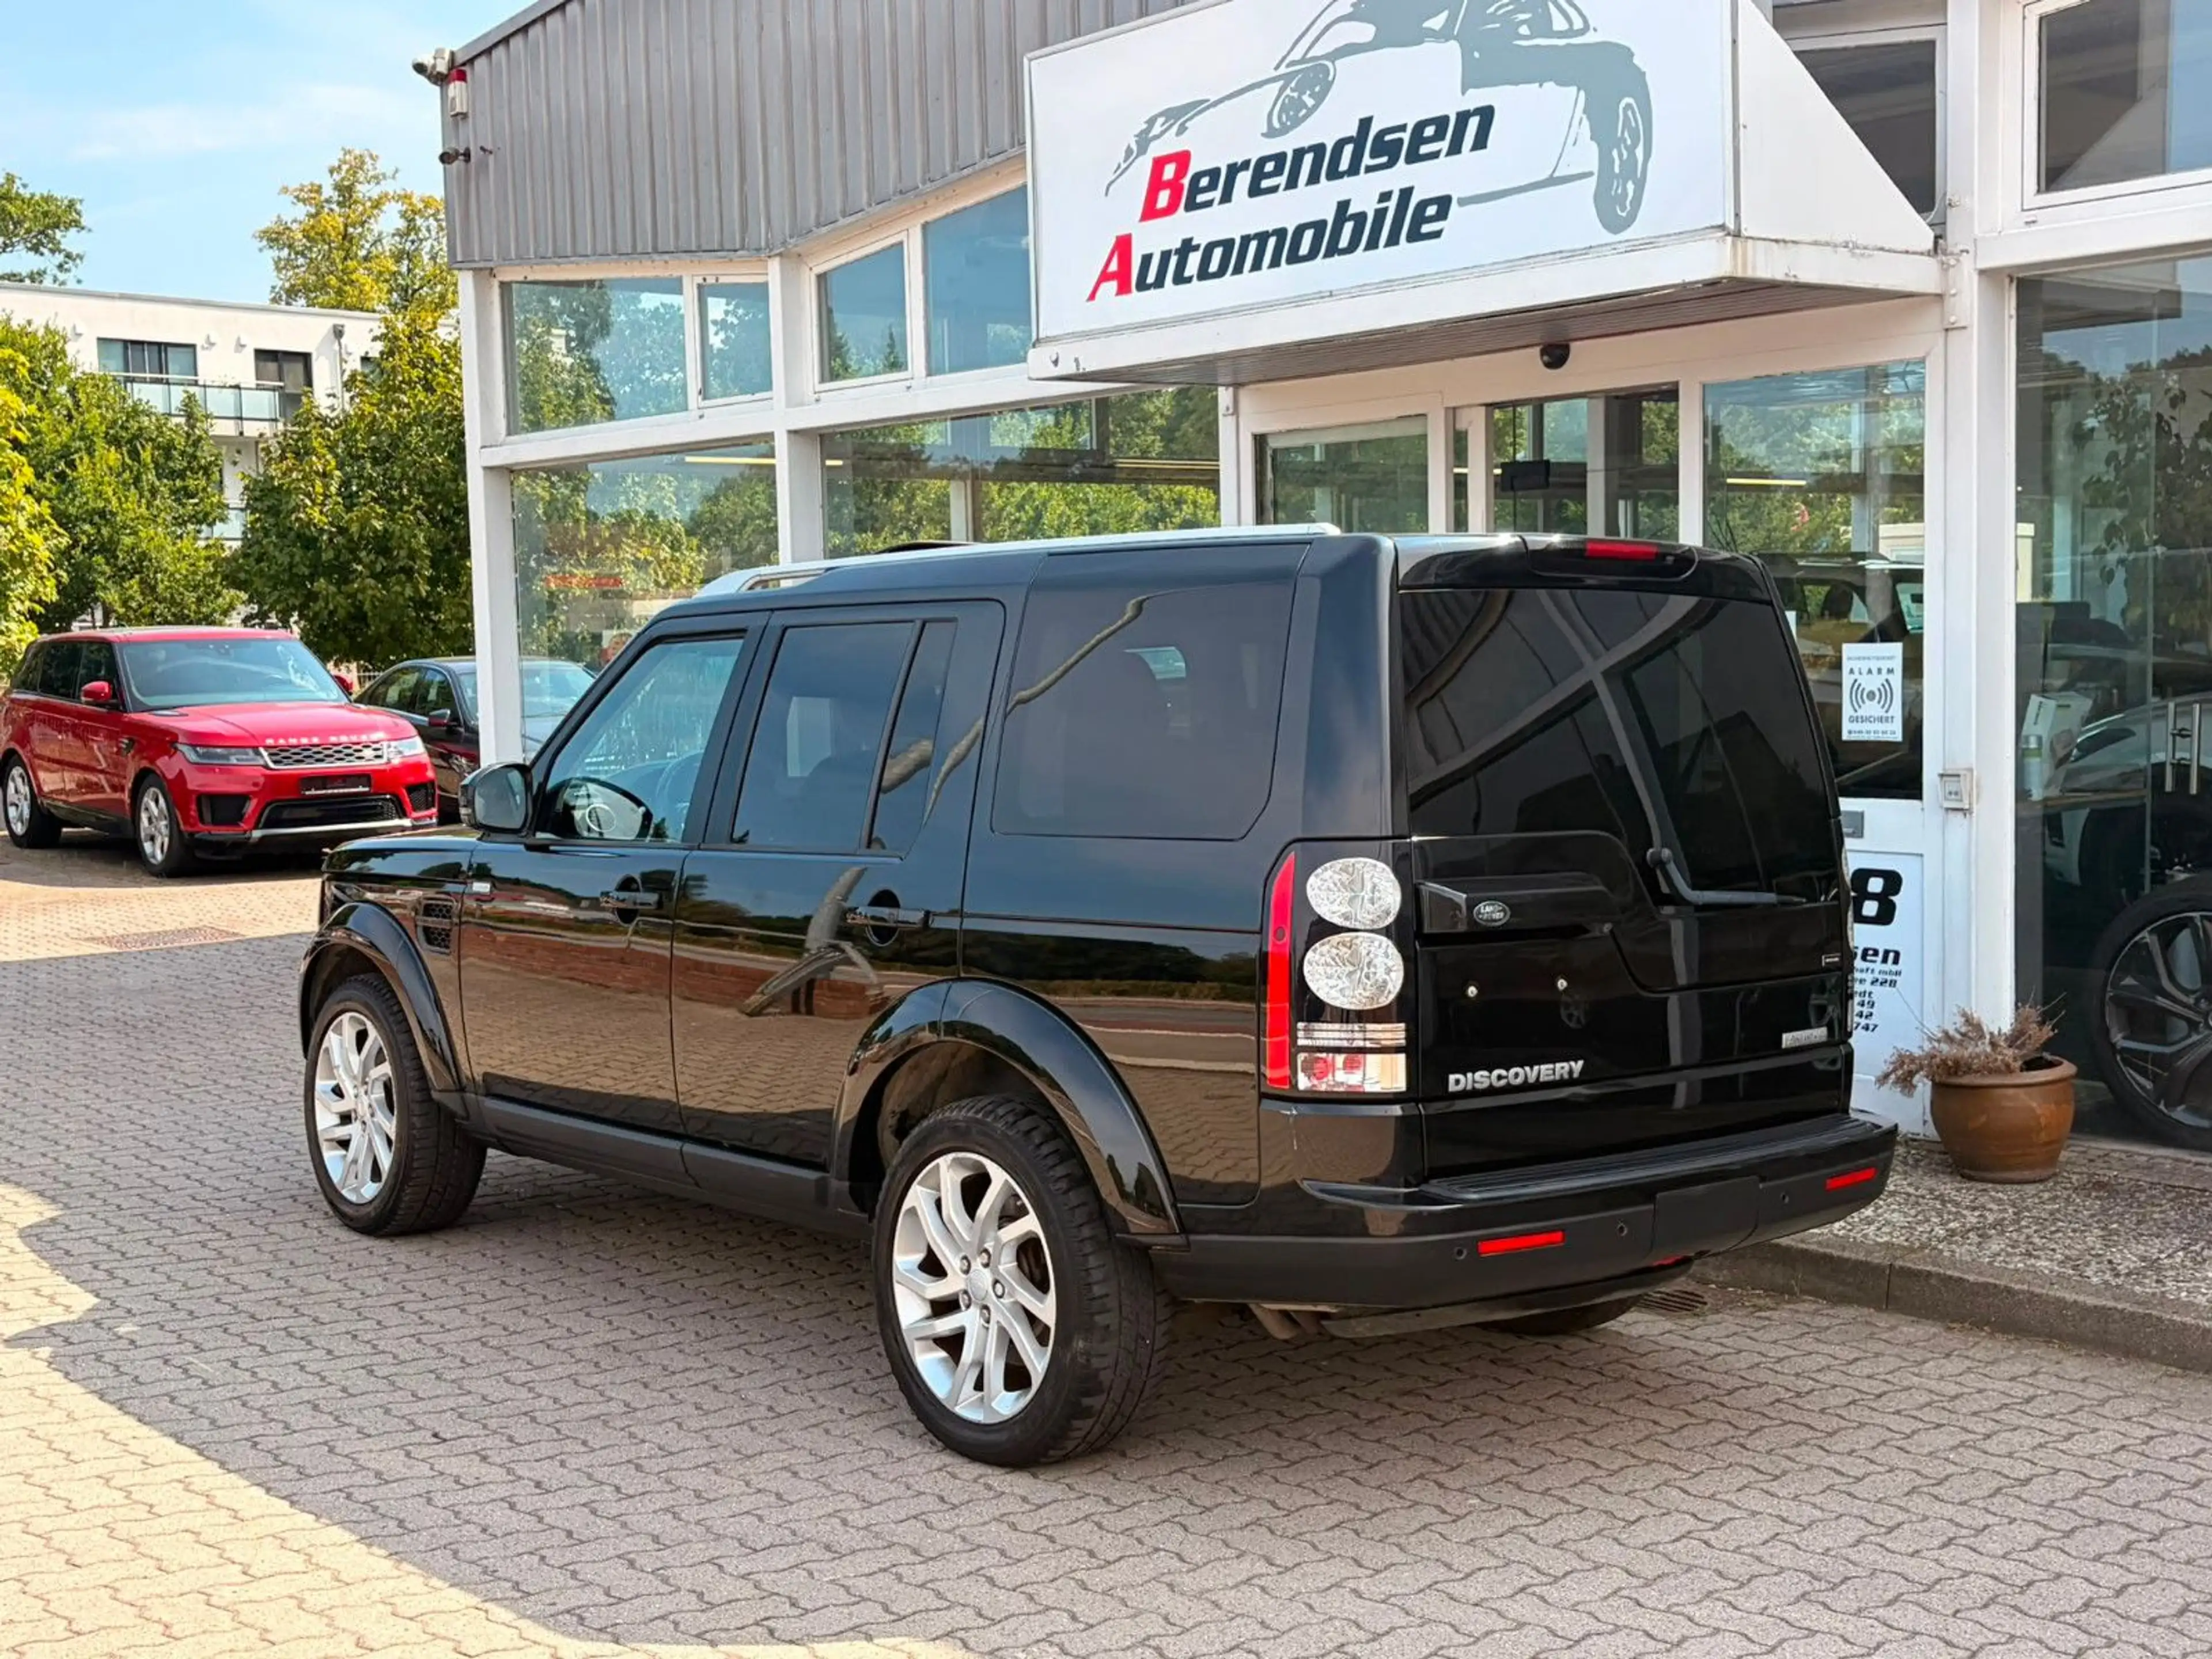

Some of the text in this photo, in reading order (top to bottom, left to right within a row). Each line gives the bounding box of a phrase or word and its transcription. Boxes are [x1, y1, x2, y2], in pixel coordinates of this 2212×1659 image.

[1141, 104, 1495, 222] Berendsen
[1088, 185, 1453, 301] Automobile
[1848, 666, 1895, 676] ALARM
[1848, 715, 1895, 724] GESICHERT
[1448, 1059, 1584, 1093] DISCOVERY
